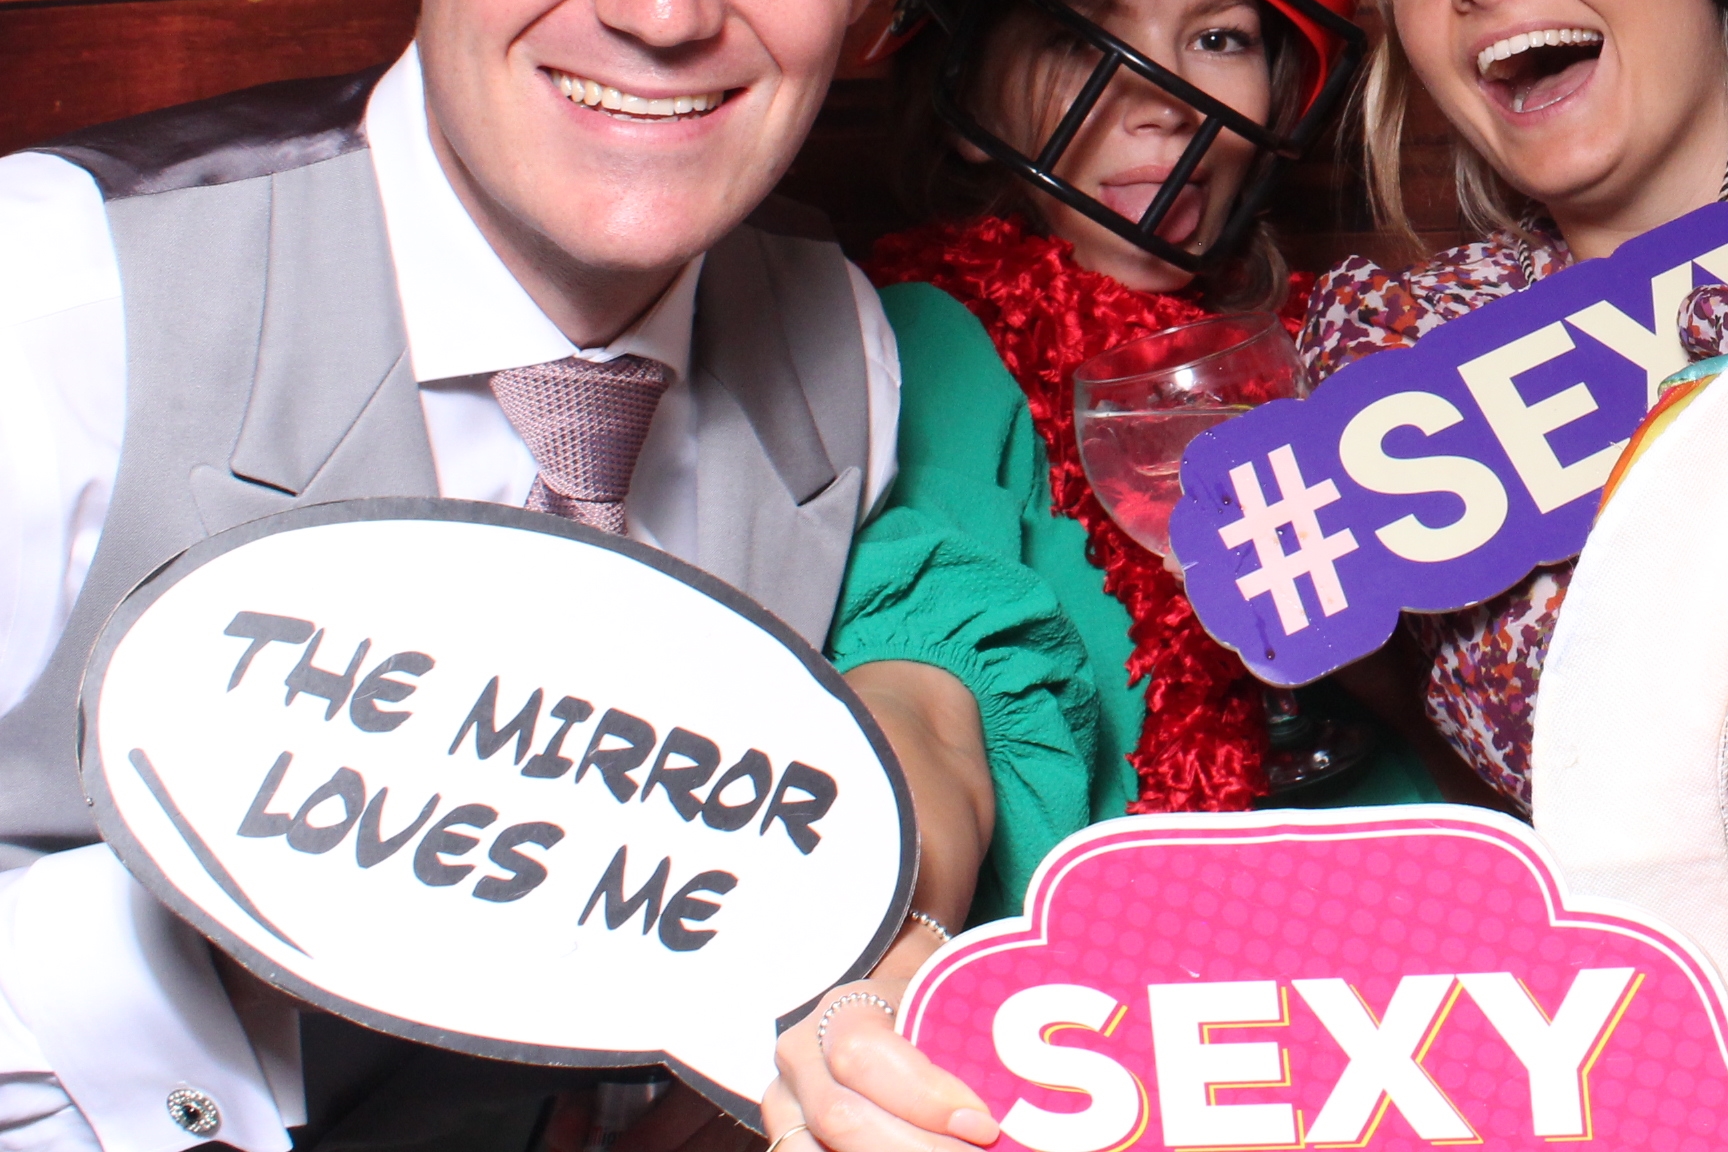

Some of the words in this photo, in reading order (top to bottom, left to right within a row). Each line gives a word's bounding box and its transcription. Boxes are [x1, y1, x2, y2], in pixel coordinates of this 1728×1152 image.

[223, 610, 436, 733] THE
[447, 674, 839, 856] MIRROR
[236, 750, 566, 904] LOVES
[577, 844, 740, 953] ME
[991, 966, 1643, 1151] SEXY
